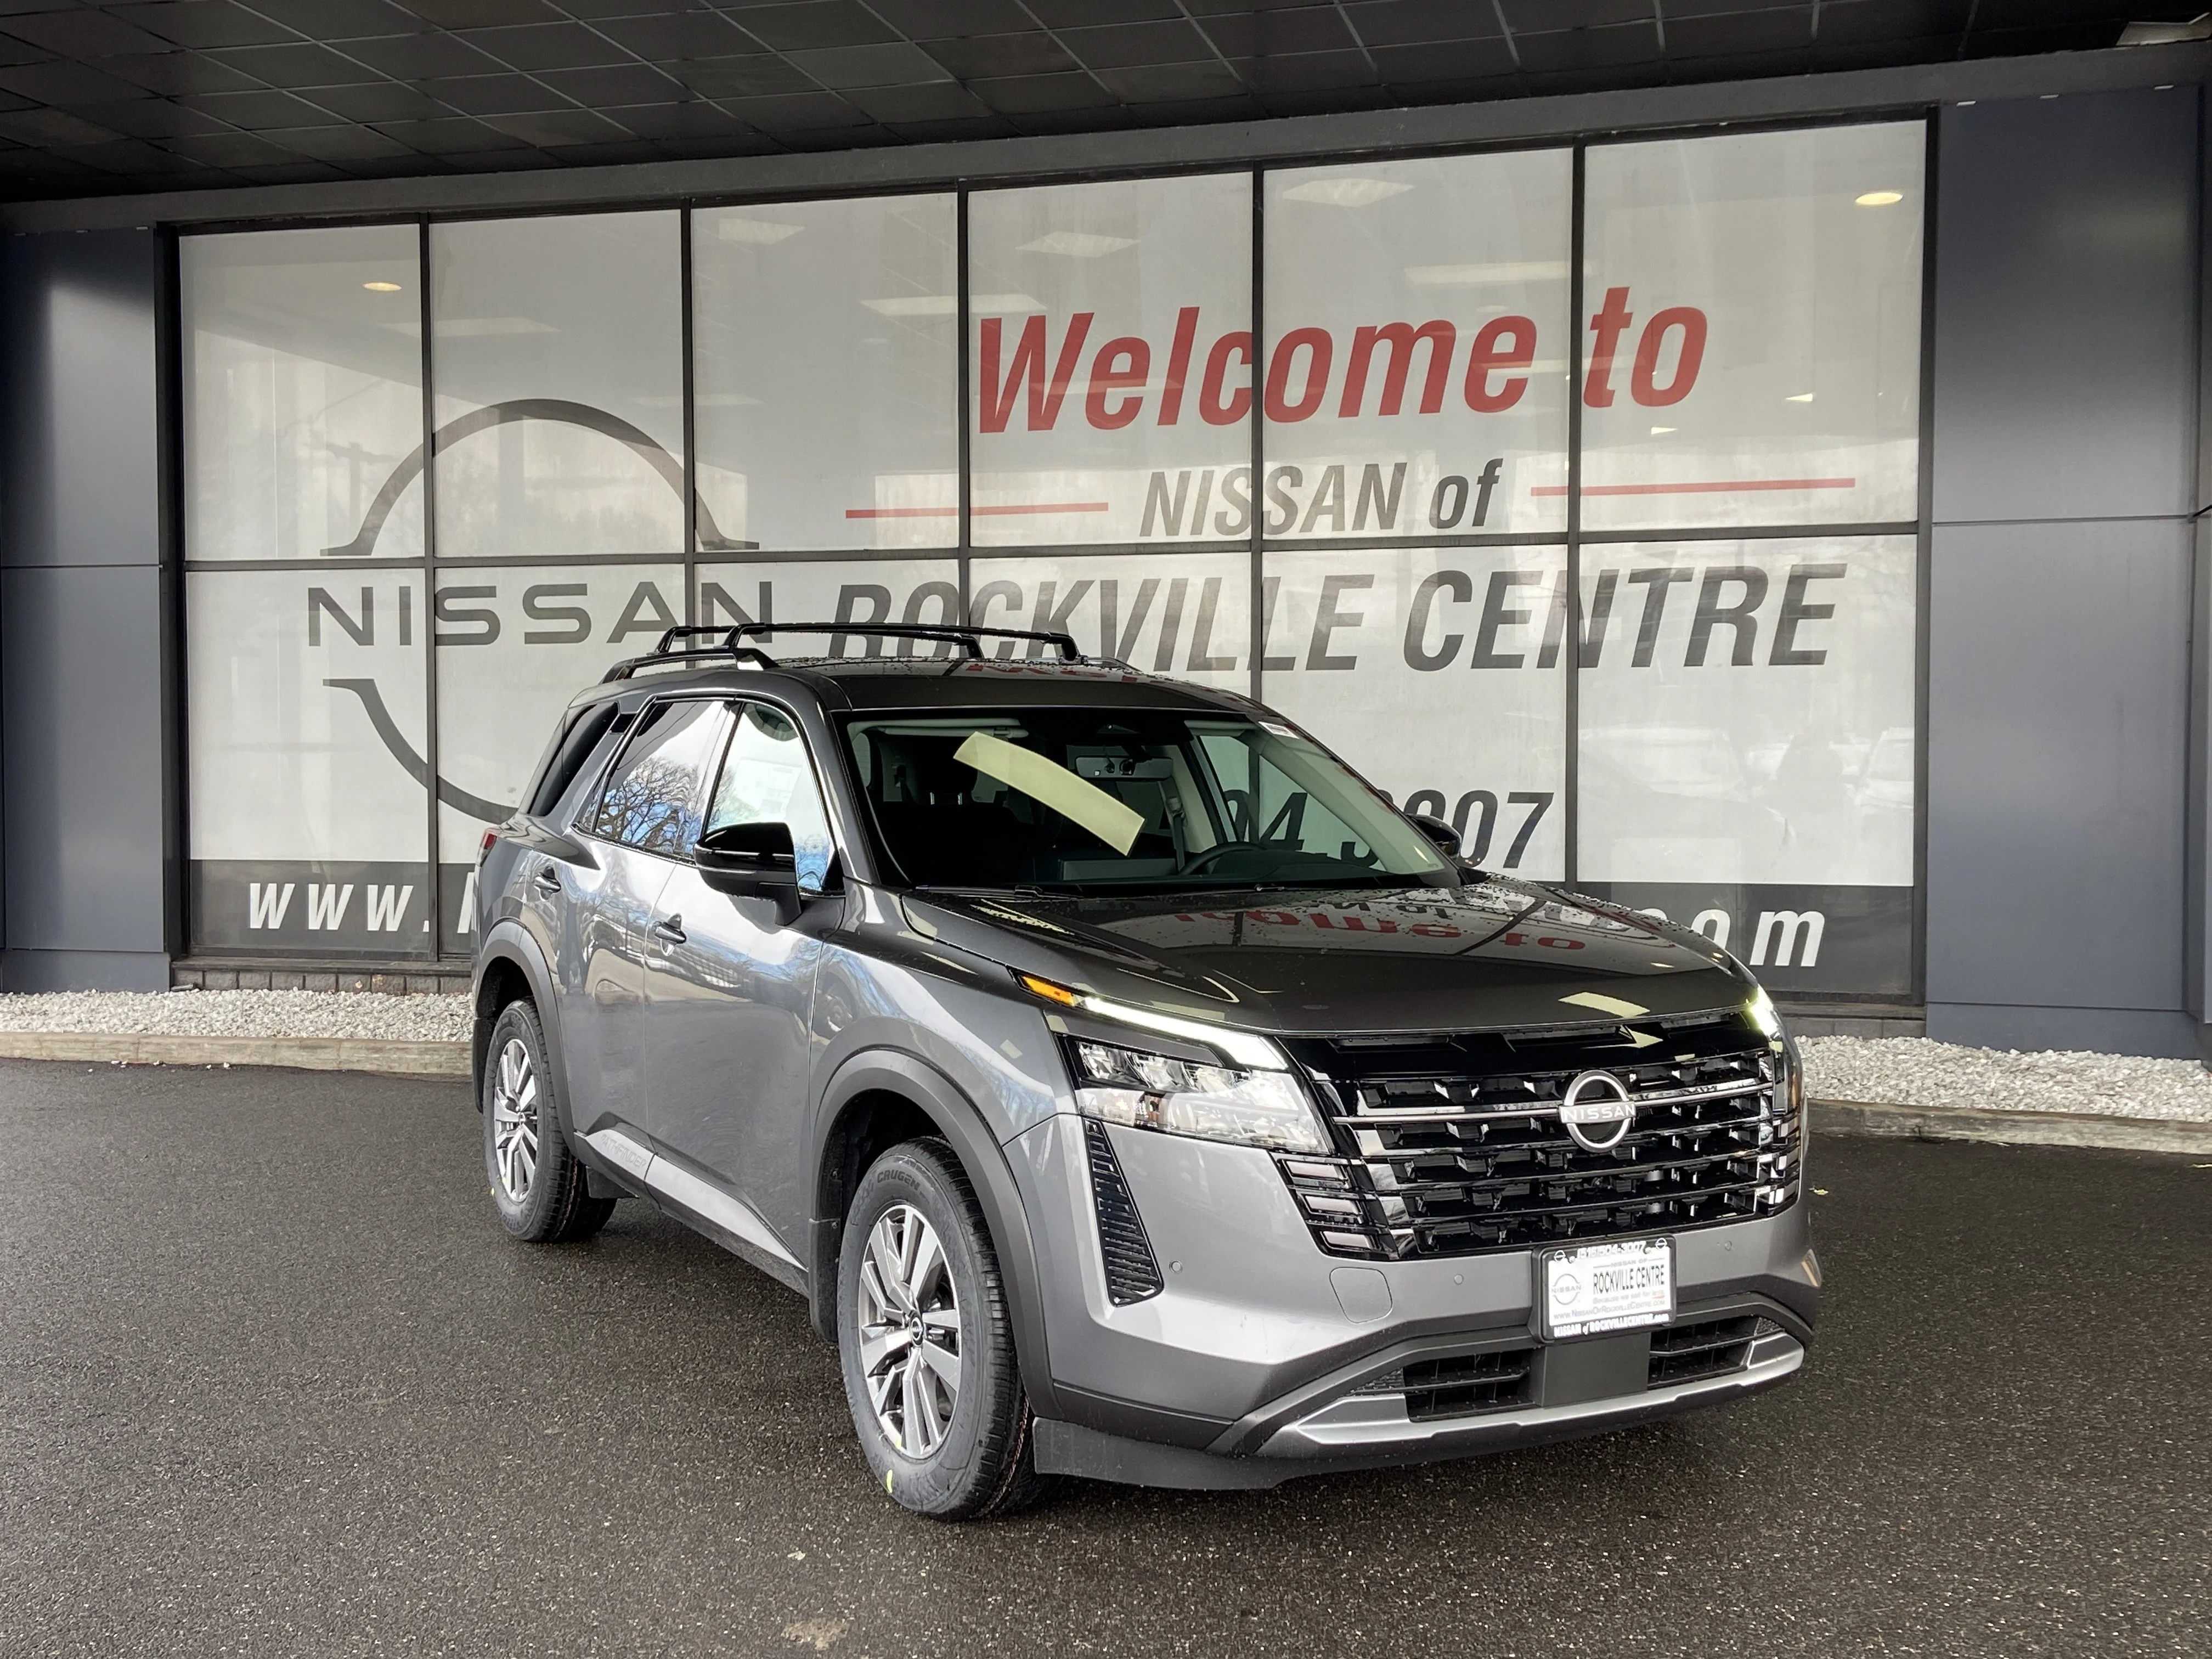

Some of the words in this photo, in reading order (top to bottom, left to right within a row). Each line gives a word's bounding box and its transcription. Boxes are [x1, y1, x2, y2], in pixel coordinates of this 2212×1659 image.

[979, 306, 1537, 435] Welcome
[1583, 287, 1707, 408] to
[1139, 462, 1406, 539] NISSAN
[1430, 459, 1503, 530] of
[308, 581, 772, 647] NISSAN
[830, 573, 1374, 672] ROCKVILLE
[1403, 563, 1847, 672] CENTRE
[1564, 1104, 1635, 1120] NISSAN
[1551, 1284, 1582, 1294] NISSAN
[1593, 1268, 1634, 1295] ROCKVILLE
[1636, 1264, 1665, 1290] CENTRE
[1554, 1324, 1581, 1337] NISSAN
